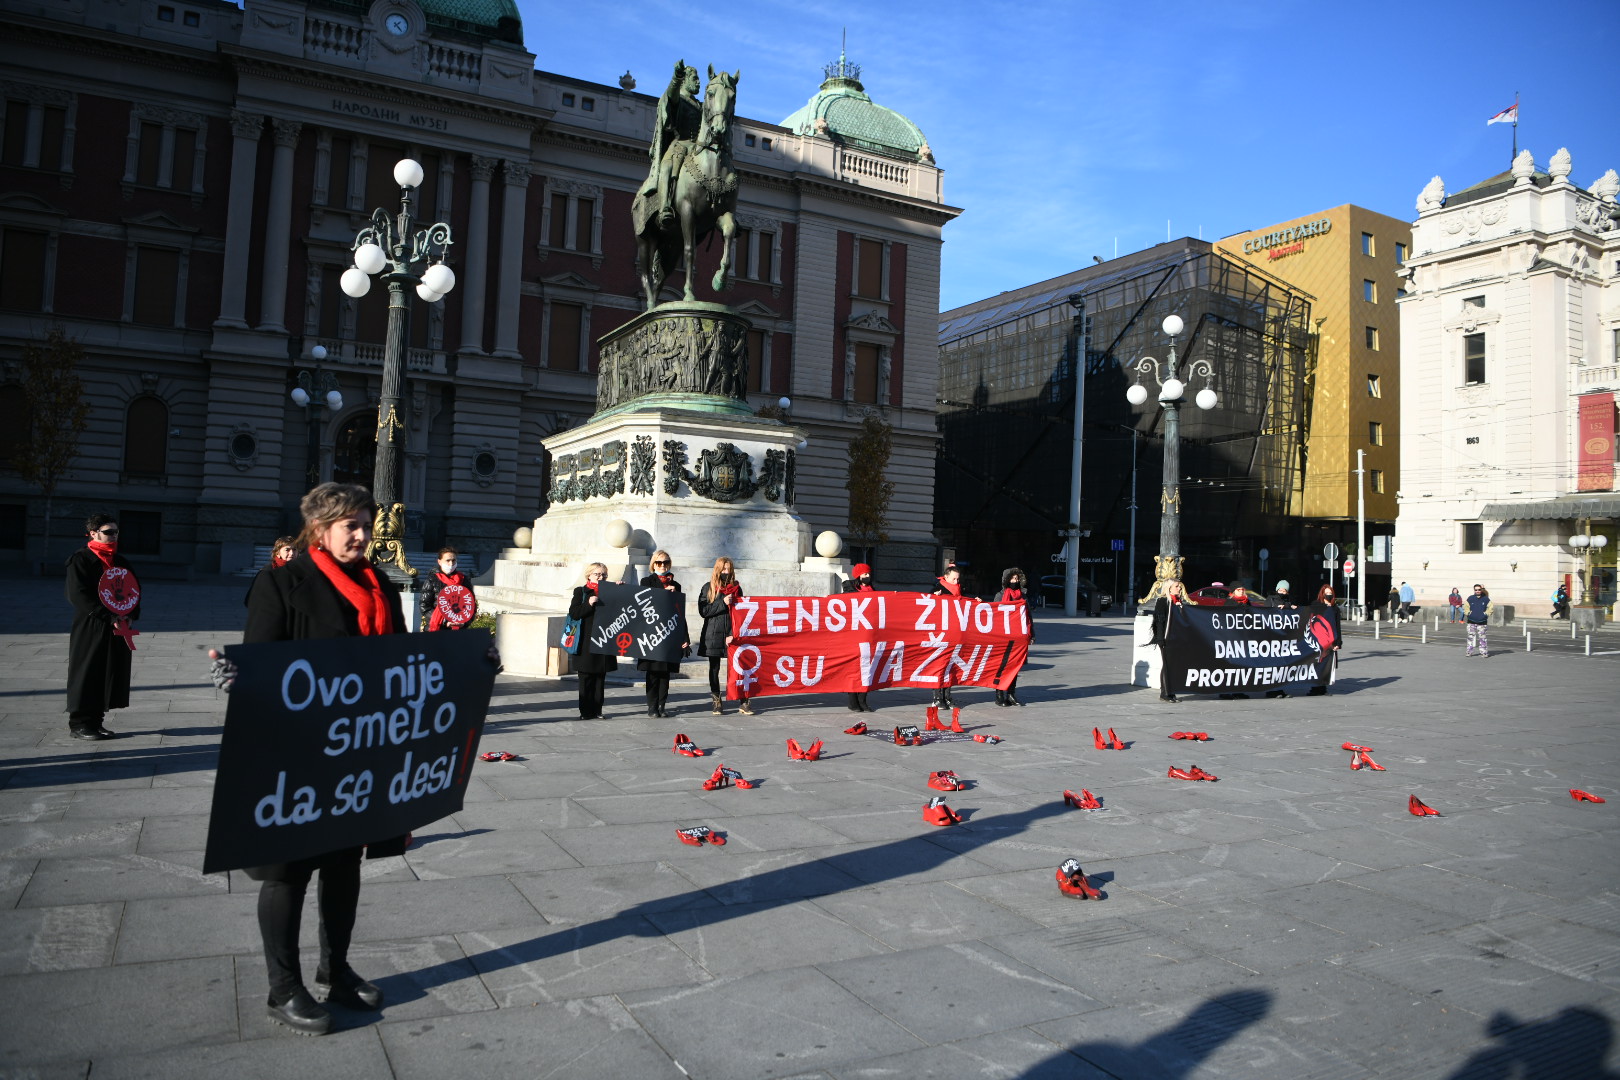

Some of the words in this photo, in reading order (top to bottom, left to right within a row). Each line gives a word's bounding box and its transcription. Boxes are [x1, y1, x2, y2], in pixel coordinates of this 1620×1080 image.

[332, 99, 400, 122] НАРОДНИ
[1242, 218, 1332, 255] COURTYARD
[444, 585, 464, 595] STOP
[635, 588, 660, 625] Lives
[591, 605, 637, 648] Women's
[734, 596, 886, 637] ŽENSKI
[915, 593, 1028, 635] ŽIVOTI
[1212, 613, 1224, 630] 6.
[1226, 613, 1300, 630] DECEMBAR
[1214, 640, 1246, 659] DAN
[1248, 639, 1301, 659] BORBE
[281, 658, 364, 711] Ovo
[384, 653, 445, 709] nije
[773, 655, 825, 688] SU
[1185, 668, 1252, 687] PROTIV
[1254, 663, 1318, 685] FEMICIDA
[254, 770, 322, 828] da
[330, 769, 374, 817] se
